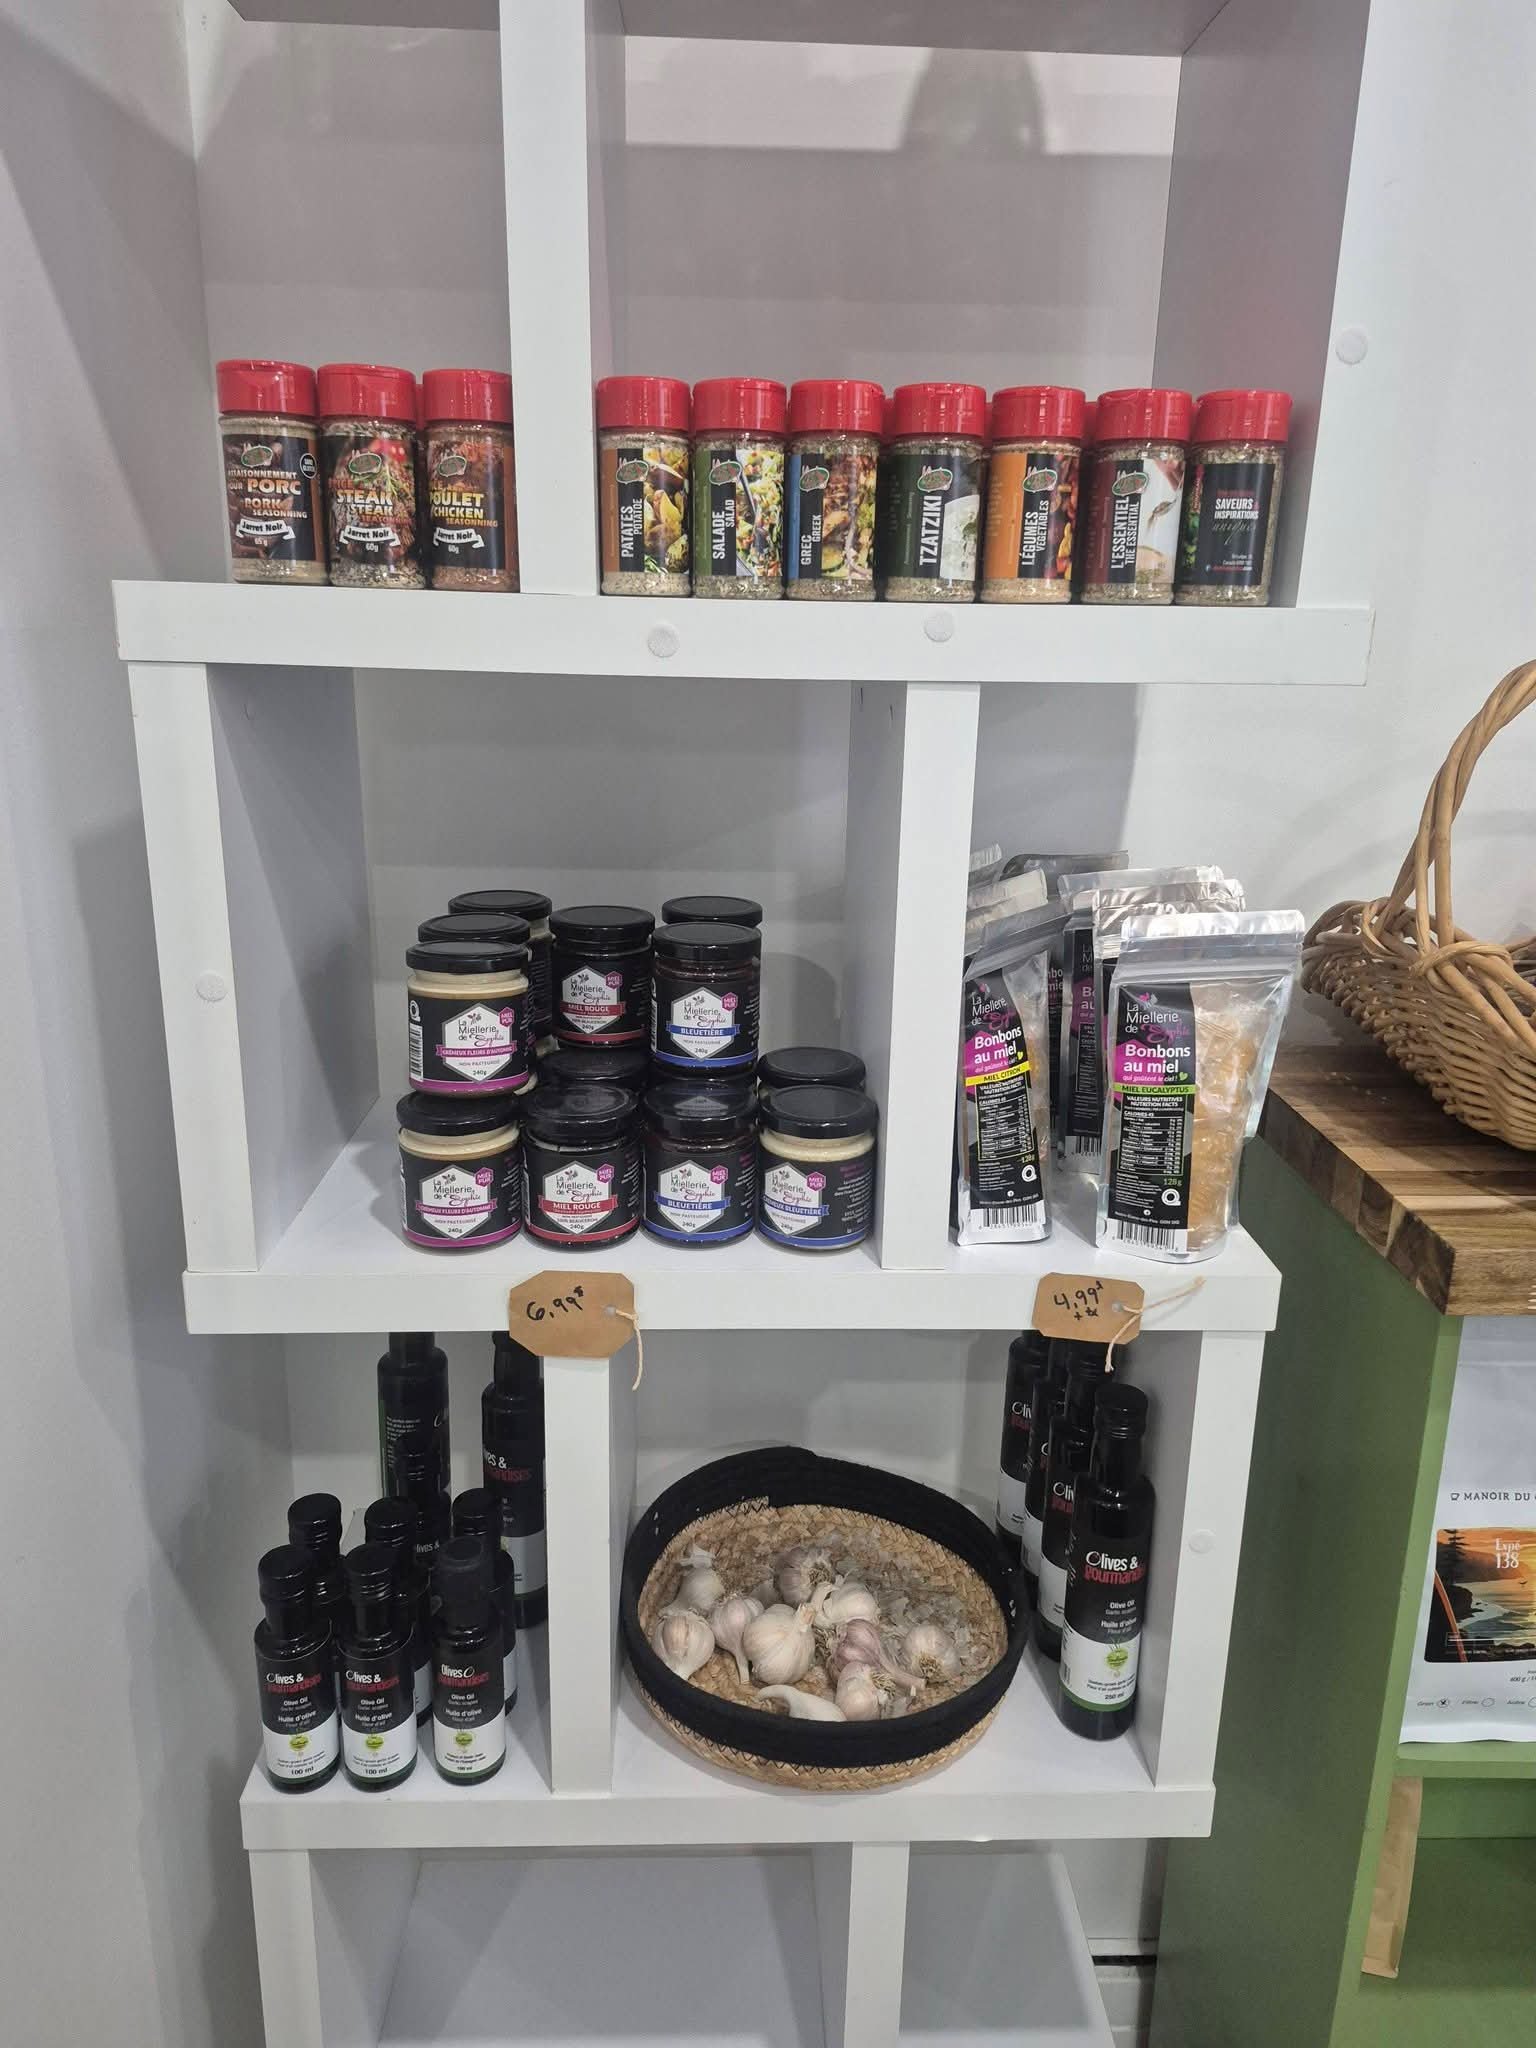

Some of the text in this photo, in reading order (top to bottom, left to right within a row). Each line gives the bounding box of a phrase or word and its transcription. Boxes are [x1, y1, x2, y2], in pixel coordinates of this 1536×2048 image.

[247, 479, 301, 495] PORC
[336, 489, 393, 505] STEAK
[244, 498, 281, 510] PORK
[350, 504, 393, 516] STEAK
[1215, 498, 1254, 510] SAVEURS
[432, 505, 484, 519] CHICKEN
[633, 498, 643, 535] POTATOE
[725, 499, 735, 528] SALAD
[1214, 510, 1259, 520] INSPIRATIONS
[242, 521, 283, 532] Jarret Noir
[347, 526, 389, 538] Jarret Noir
[620, 505, 634, 558] PATATES
[812, 514, 822, 543] GREEK
[919, 495, 943, 566] TZATZIKI
[1035, 500, 1050, 552] VEGETABLES
[1110, 496, 1130, 569] L'ESSENTIEL
[1124, 501, 1140, 564] THE ESSENTIAL
[437, 528, 473, 540] Jarret Noir
[712, 510, 726, 559] SALADE
[1019, 511, 1039, 565] LÉGUMES
[801, 534, 812, 565] GREC
[571, 984, 603, 992] Miellerie
[972, 994, 982, 1005] La
[683, 1007, 719, 1016] Miellerie
[1127, 1002, 1139, 1012] La
[971, 1016, 982, 1026] de
[1126, 1011, 1179, 1023] Miellerie
[458, 1026, 497, 1034] Miellerie
[1125, 1024, 1138, 1033] de
[975, 1026, 1022, 1050] Bonbons
[974, 1041, 1017, 1064] au miel
[1125, 1044, 1191, 1058] Bonbons
[1123, 1060, 1179, 1073] au miel
[983, 1067, 1021, 1082] MIEL CITRON
[1121, 1085, 1189, 1094] MIEL EUCALYPTUS
[433, 1185, 473, 1194] Miellerie
[556, 1181, 594, 1190] Miellerie
[671, 1178, 708, 1188] Miellerie
[772, 1179, 804, 1192] Miellerie
[553, 1202, 601, 1210] MIEL ROUGE
[667, 1200, 713, 1210] BLEUETIÈRE
[1011, 1401, 1032, 1419] Oliv
[1053, 1482, 1074, 1501] Oliv
[1463, 1492, 1531, 1501] MANOIR DU
[1085, 1551, 1138, 1572] Olives &
[1496, 1552, 1519, 1569] 138
[1101, 1620, 1118, 1628] Huile
[345, 1669, 382, 1684] Olives &
[441, 1664, 463, 1678] Olives
[266, 1672, 304, 1685] Olives &
[361, 1697, 385, 1706] Olive Oil
[278, 1710, 317, 1723] Huile d'olive
[355, 1711, 393, 1722] Huile d'olive
[445, 1708, 460, 1717] Huile
